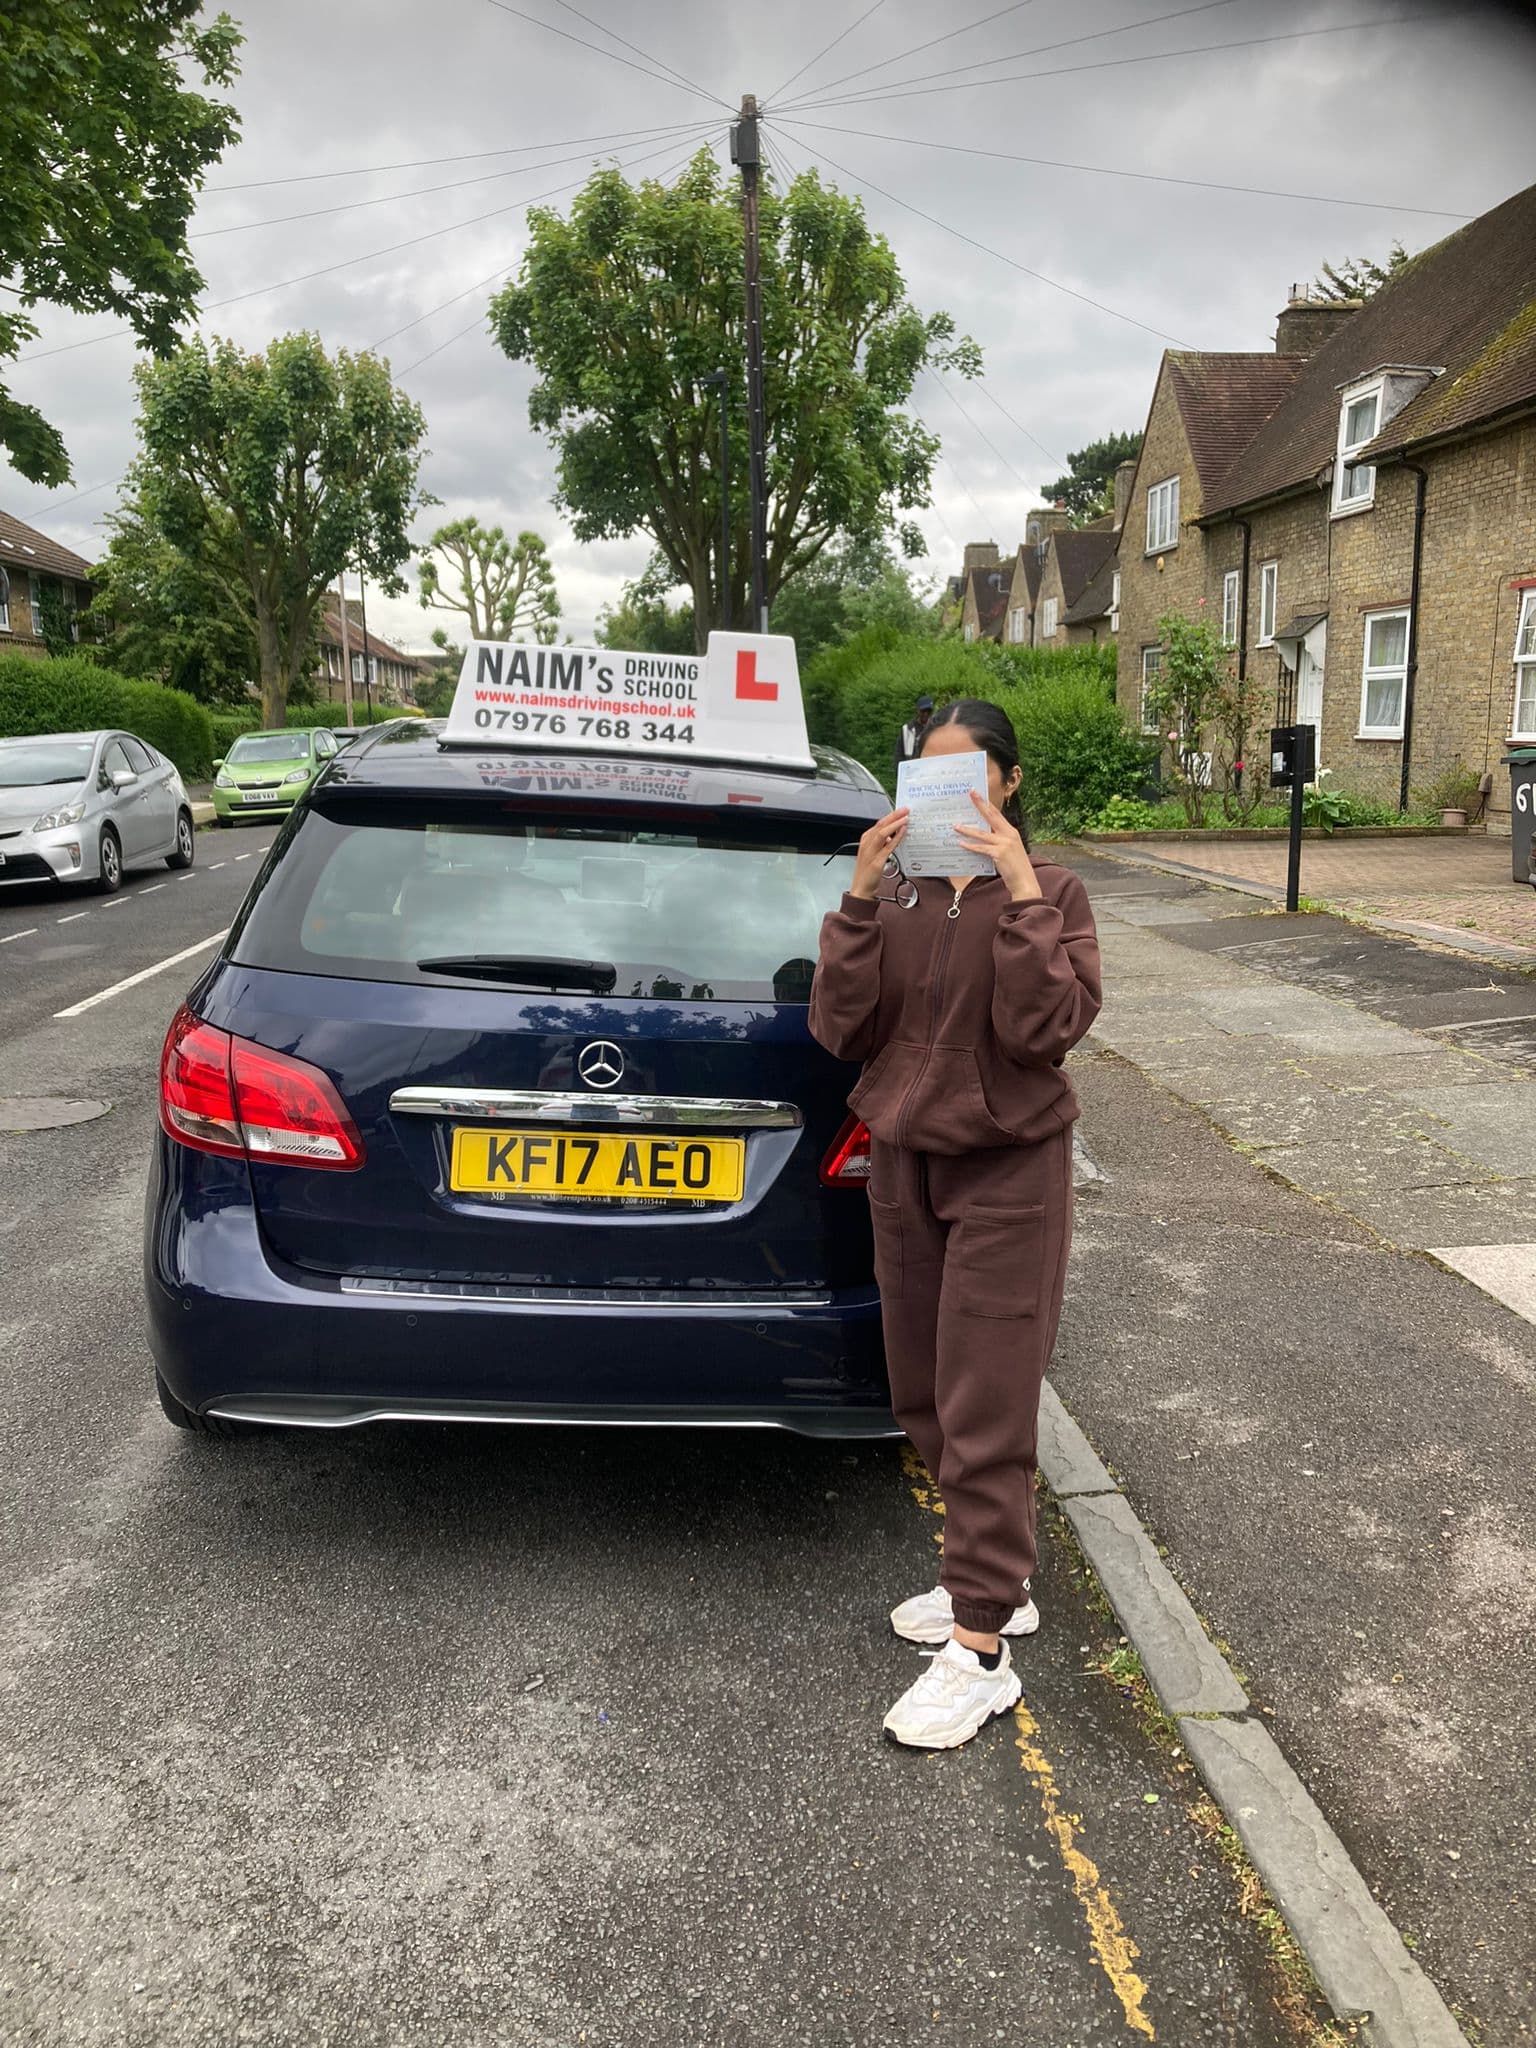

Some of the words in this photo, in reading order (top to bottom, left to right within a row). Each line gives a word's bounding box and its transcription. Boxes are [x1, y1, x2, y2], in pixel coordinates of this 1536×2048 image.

[625, 658, 699, 681] DRIVING
[736, 650, 778, 701] L
[475, 689, 696, 719] www.naimsdrivingschool.uk
[623, 679, 698, 701] SCHOOL
[474, 708, 566, 734] 07976
[578, 716, 630, 739] 768
[642, 721, 695, 744] 344
[487, 1136, 600, 1184] KF17
[616, 1141, 712, 1188] AEO
[490, 1192, 506, 1201] MB
[690, 1198, 706, 1208] MB
